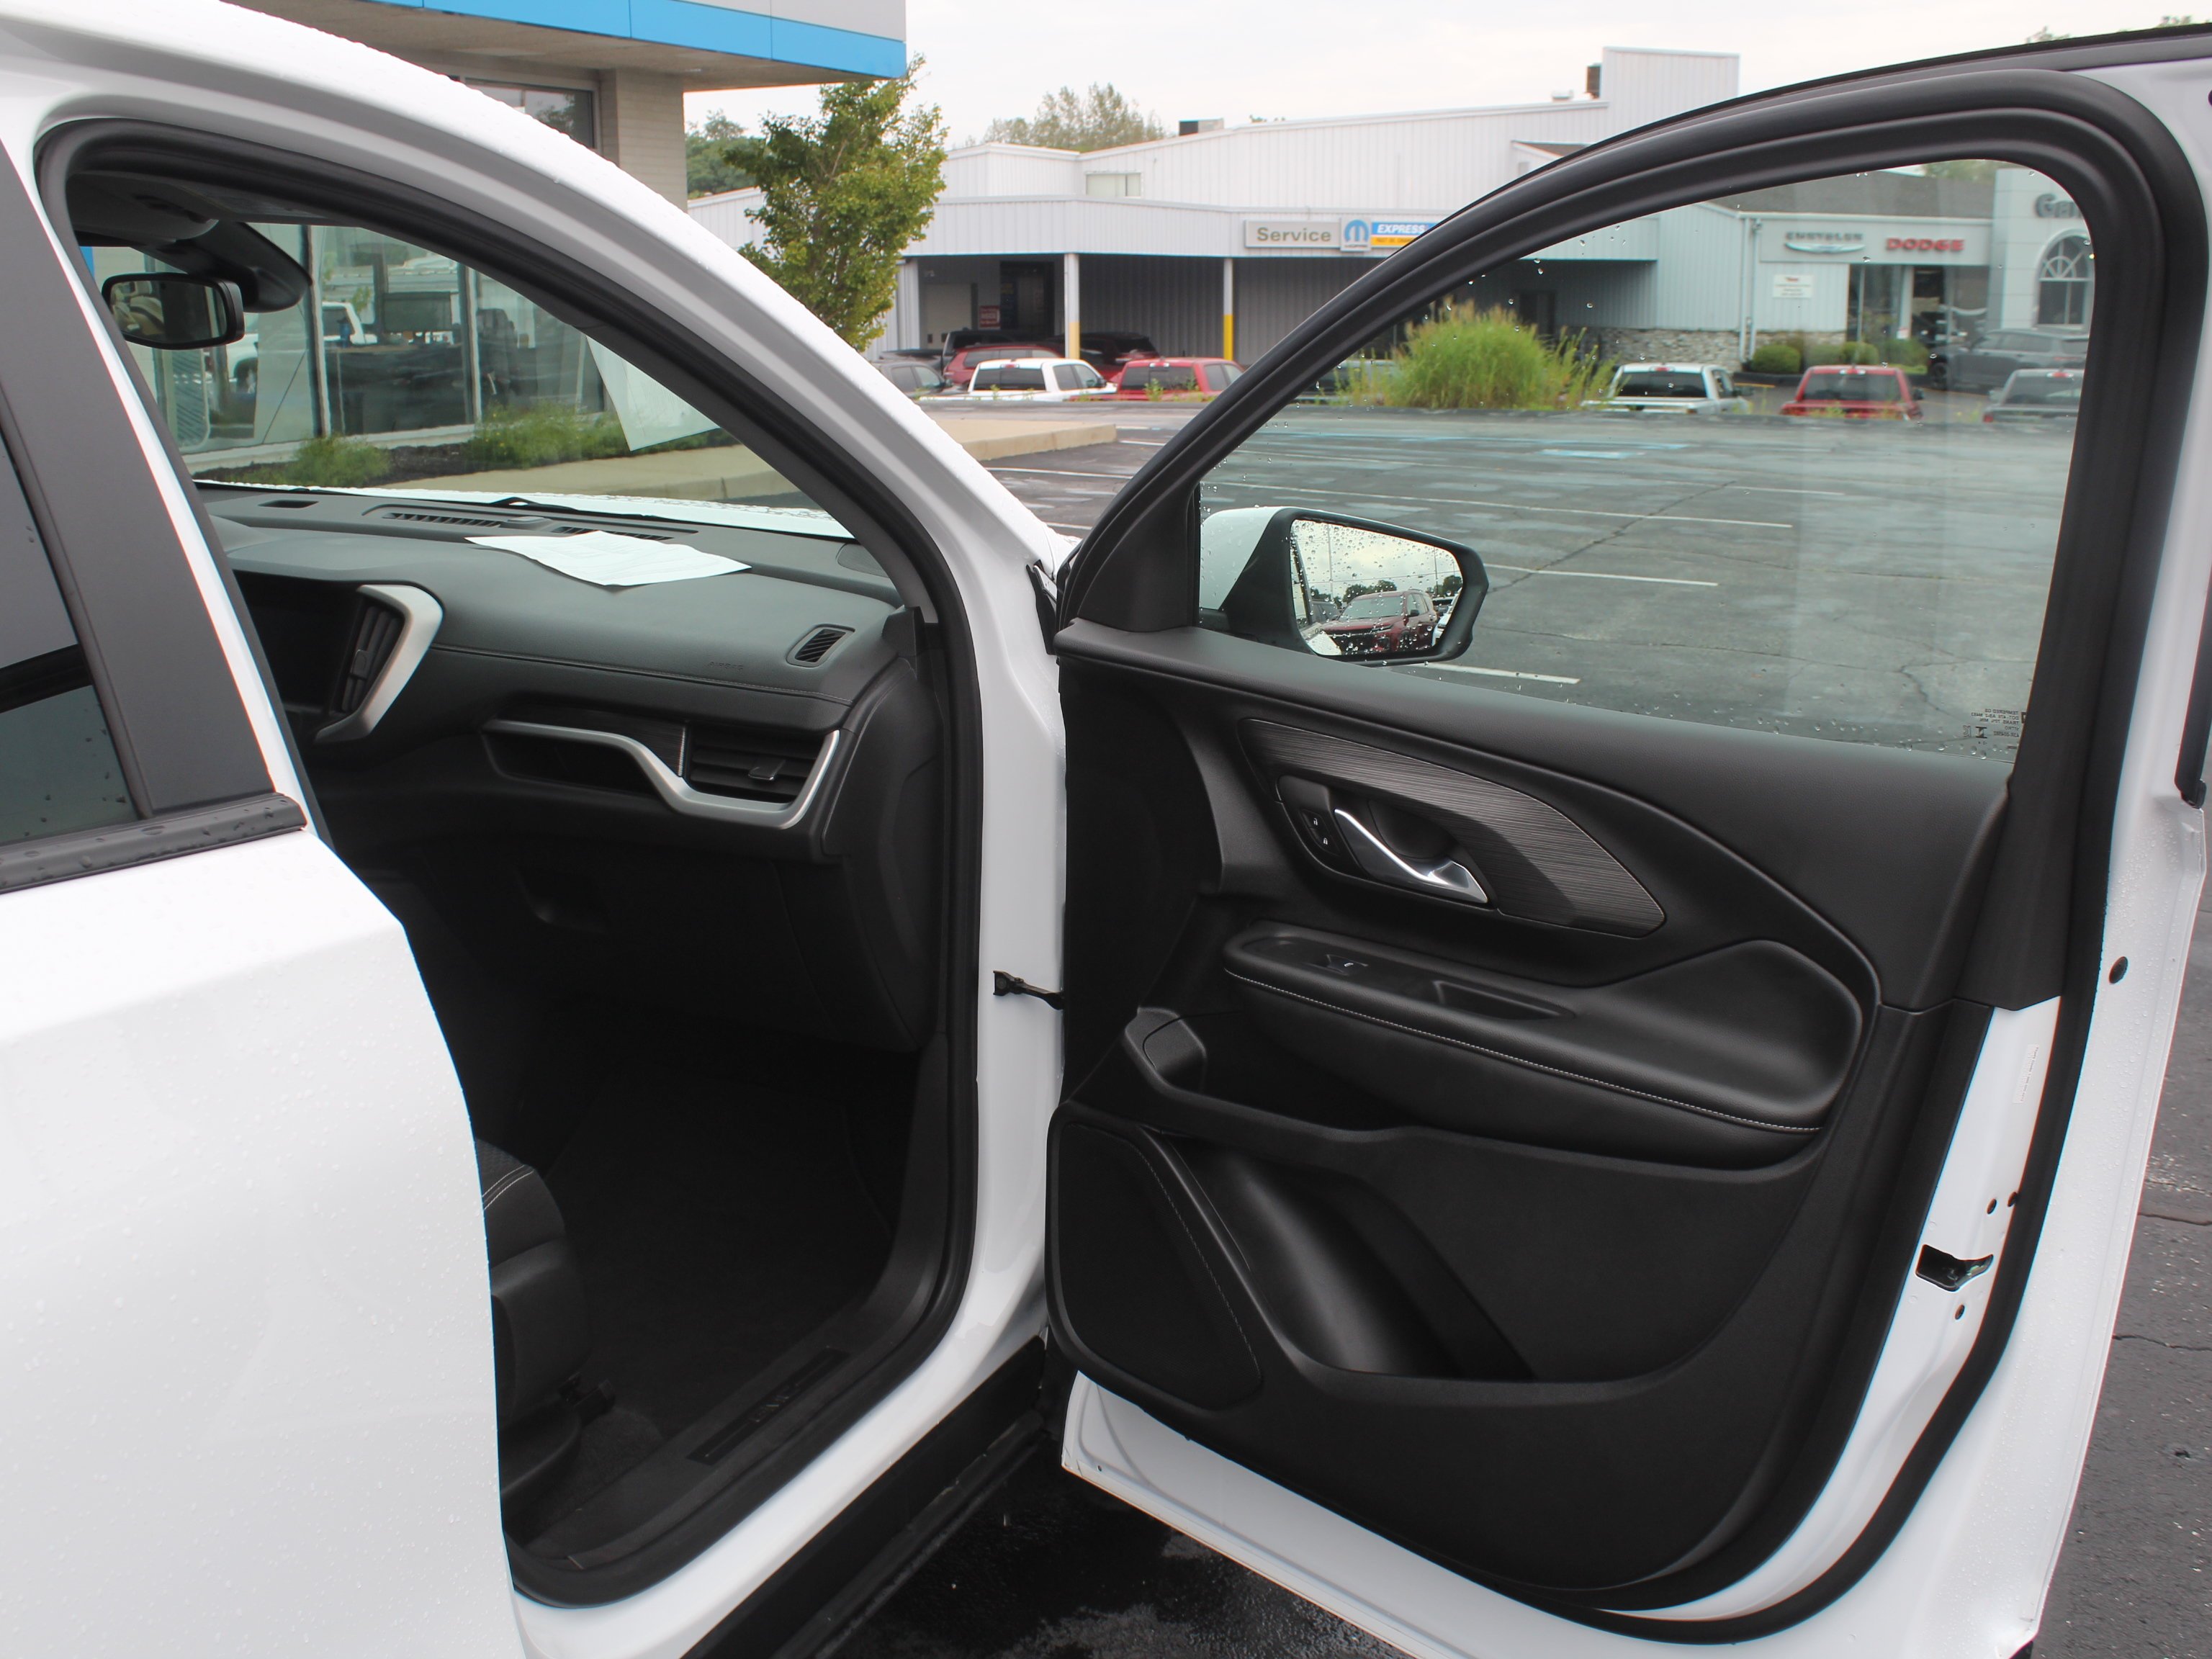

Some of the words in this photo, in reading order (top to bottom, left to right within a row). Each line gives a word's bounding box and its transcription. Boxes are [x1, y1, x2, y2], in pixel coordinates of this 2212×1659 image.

[1256, 227, 1332, 243] Service
[1377, 224, 1426, 234] EXPRESS
[1886, 237, 1966, 252] DODGE
